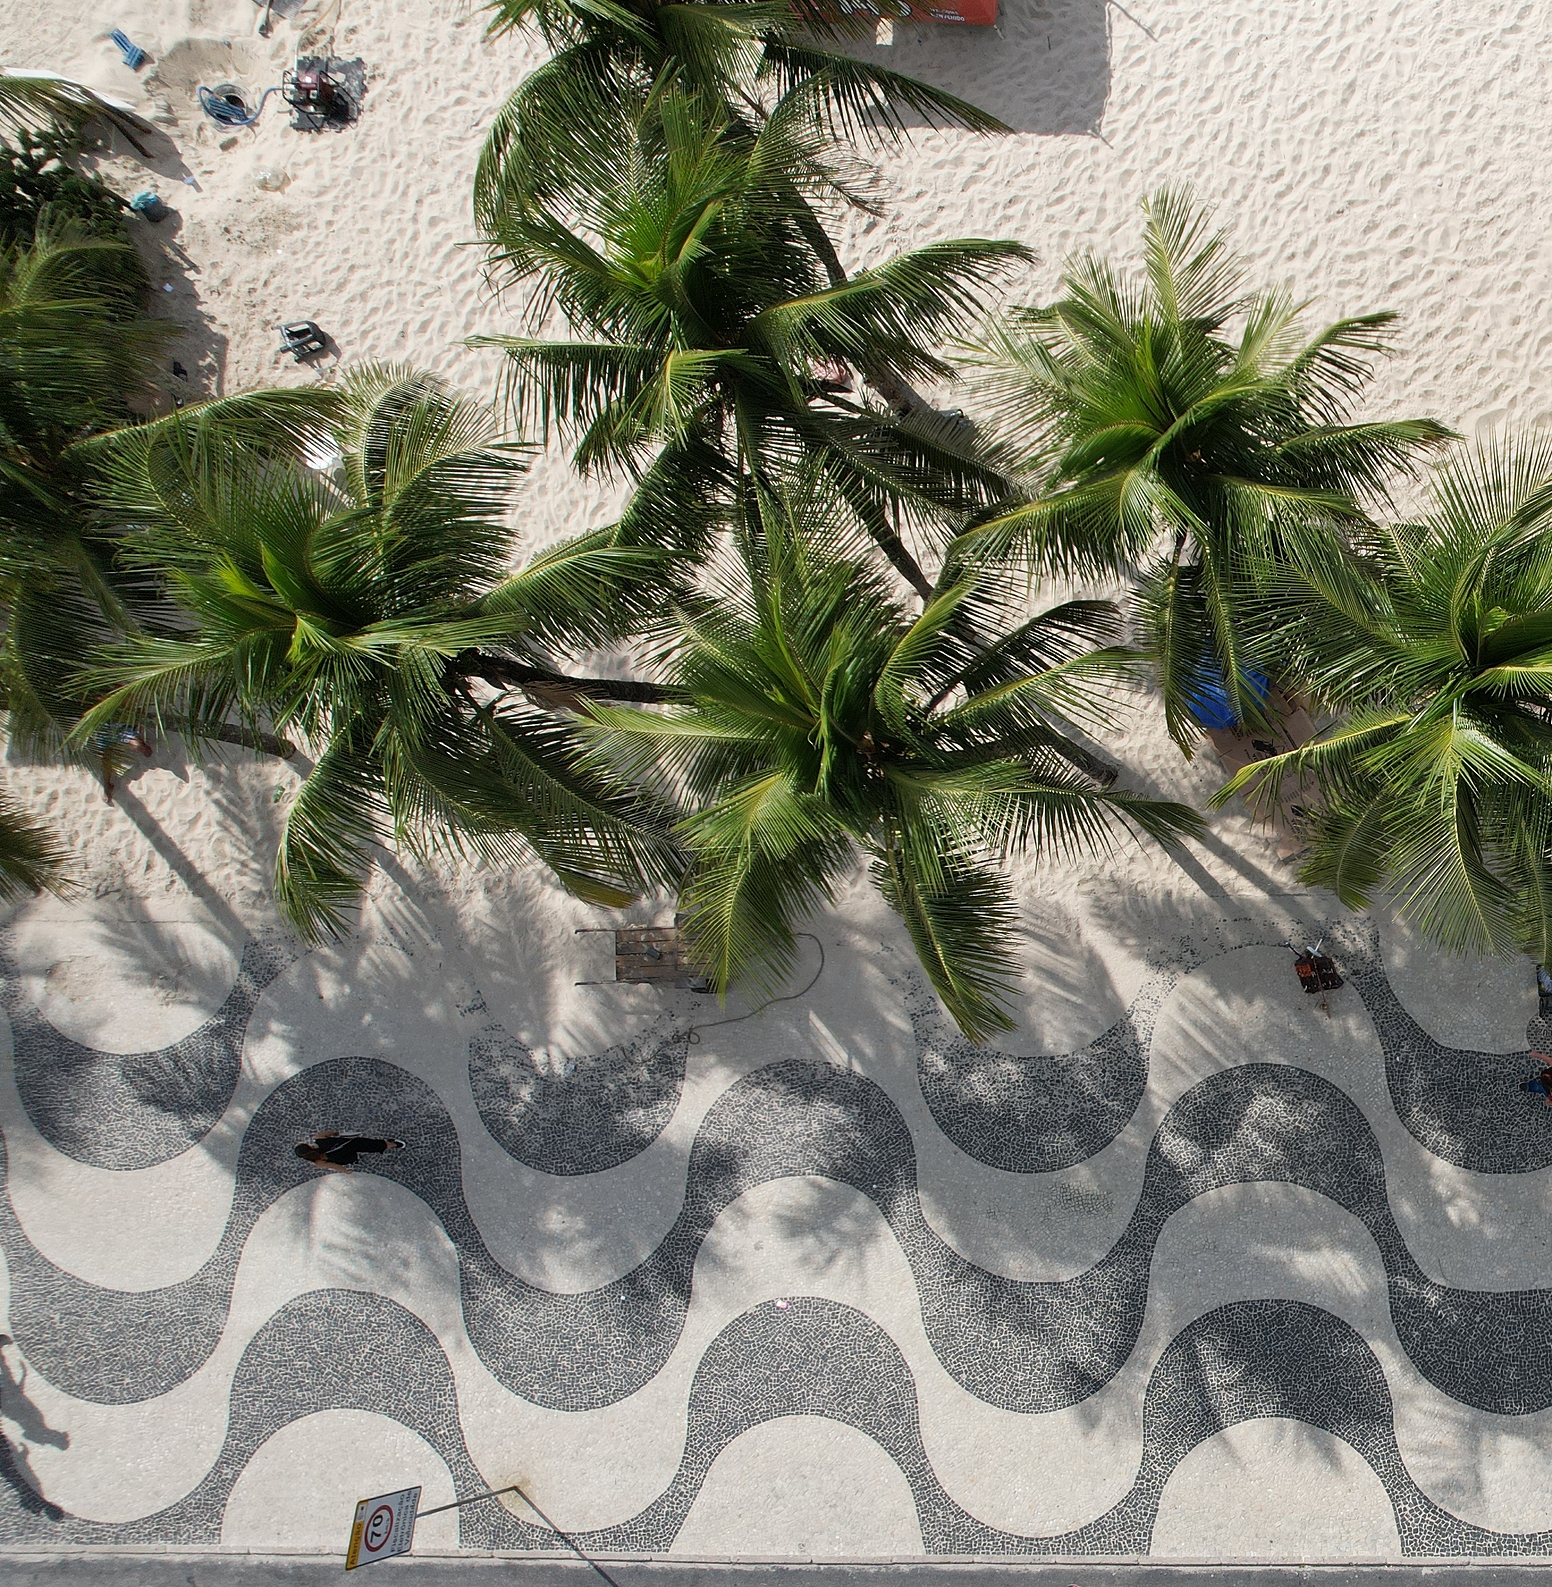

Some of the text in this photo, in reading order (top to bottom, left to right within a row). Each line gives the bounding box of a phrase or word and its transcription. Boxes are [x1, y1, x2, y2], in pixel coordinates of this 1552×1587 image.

[370, 1514, 383, 1543] 70
[391, 1494, 405, 1552] Fiscalização
[397, 1504, 409, 1552] Eletrônica
[404, 1493, 418, 1546] Velocidade
[350, 1523, 362, 1565] Atenção
